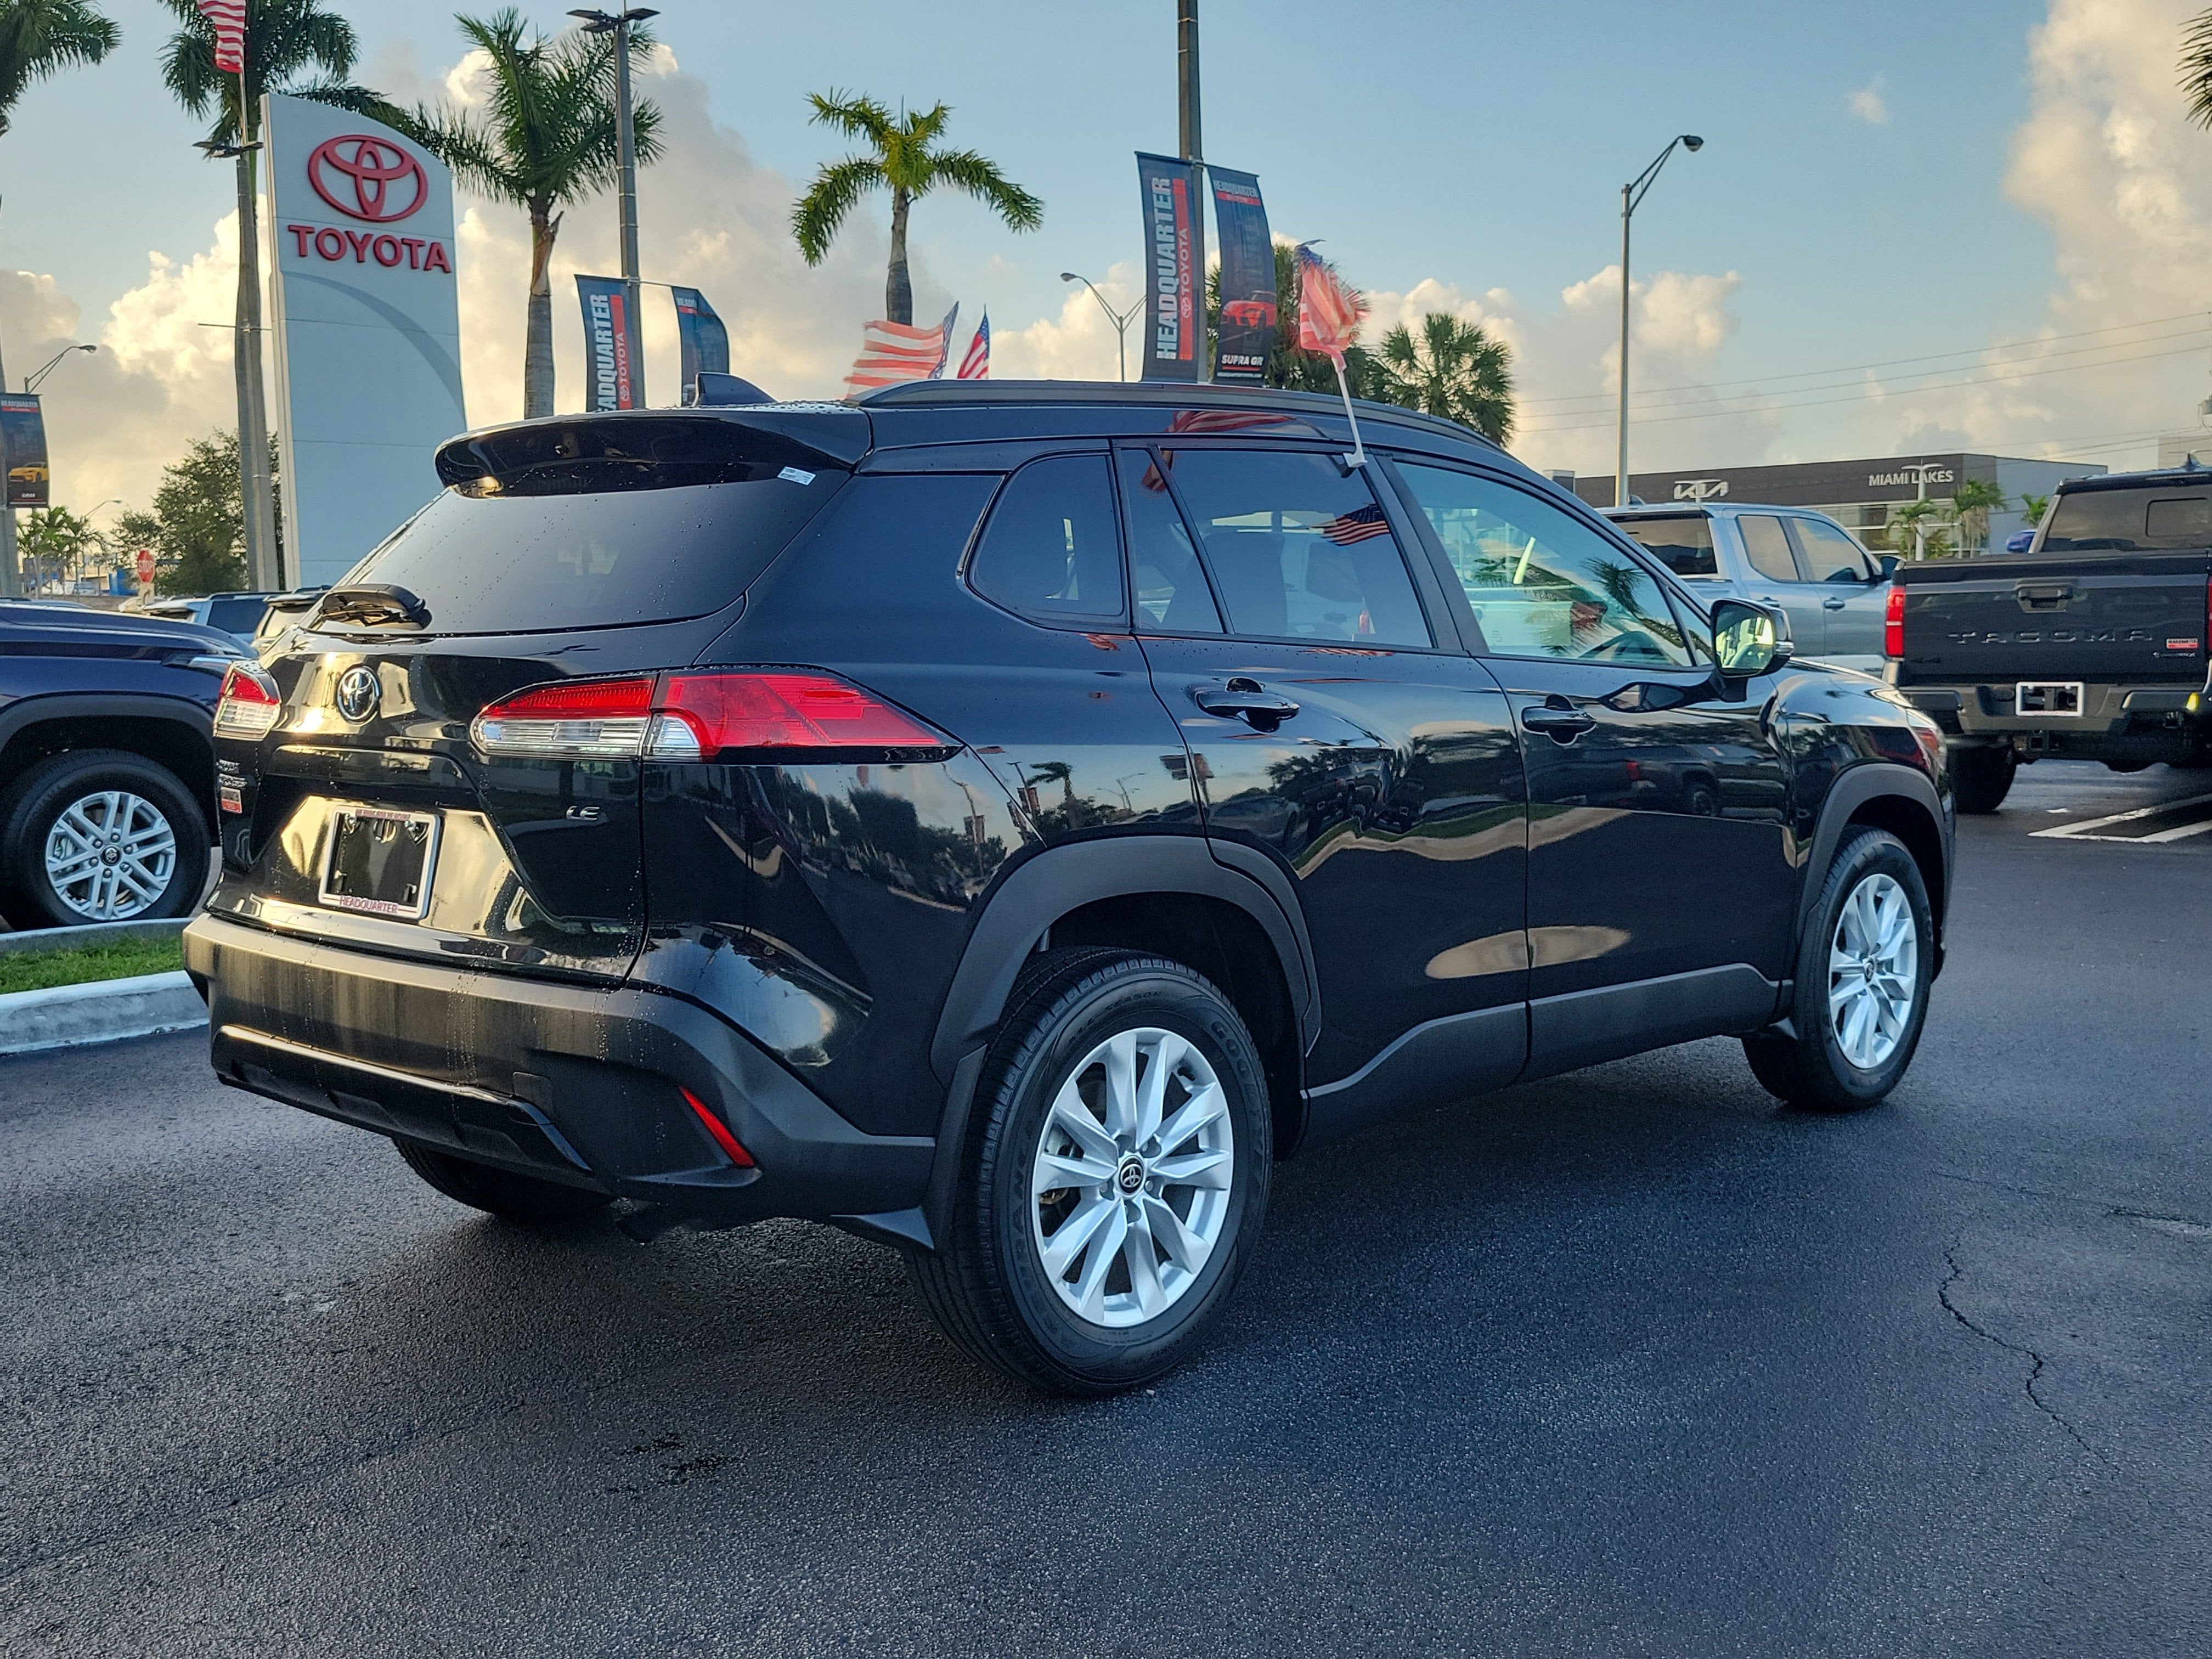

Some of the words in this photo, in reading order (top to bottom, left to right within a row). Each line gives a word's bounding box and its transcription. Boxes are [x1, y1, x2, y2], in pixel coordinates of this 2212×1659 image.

[288, 224, 452, 273] TOYOTA
[1152, 178, 1179, 360] HEADQUARTER
[1180, 228, 1190, 295] TOYOTA
[616, 331, 628, 383] TOYOTA
[1221, 354, 1250, 365] SUPRA
[1250, 356, 1264, 366] GR
[1868, 472, 1909, 486] MIAMI
[1674, 481, 1728, 500] KIA
[138, 560, 154, 573] STOP
[566, 805, 600, 821] LE
[340, 896, 398, 914] HEADQUARTER
